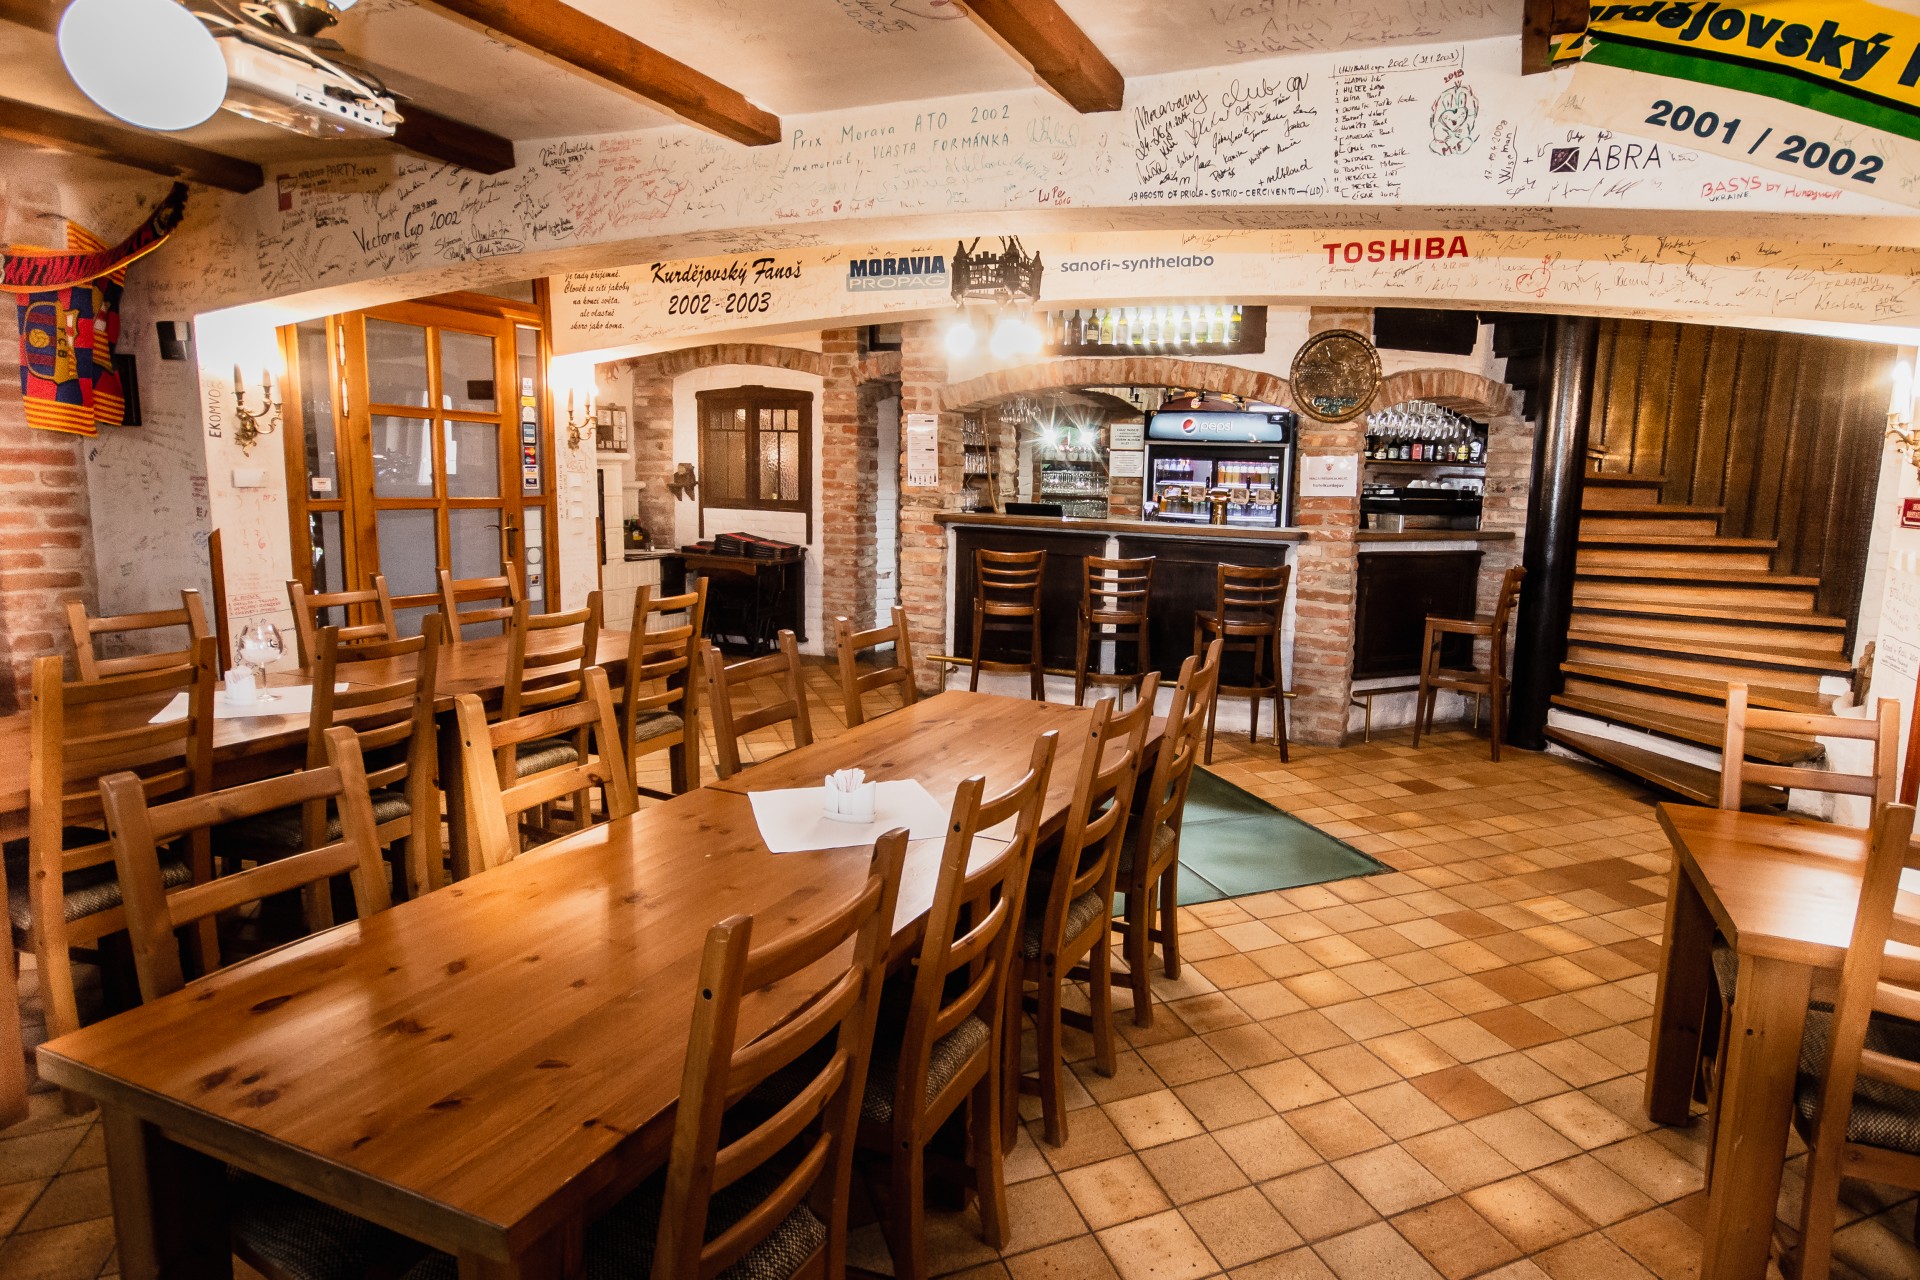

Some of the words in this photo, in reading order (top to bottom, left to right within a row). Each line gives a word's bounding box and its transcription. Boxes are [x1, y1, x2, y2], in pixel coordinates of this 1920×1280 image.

[792, 130, 822, 150] Prix
[841, 125, 895, 145] Morava
[914, 112, 948, 132] ATO
[970, 105, 1010, 123] 2002
[873, 142, 917, 160] VLASTA
[932, 132, 1009, 151] FORMÁNKA
[1644, 99, 1742, 145] 2001
[1775, 134, 1884, 185] 2002
[1583, 143, 1661, 173] ABRA
[1139, 190, 1164, 200] AGOSTO
[1701, 176, 1762, 197] BASYS
[430, 210, 461, 231] 2002
[1322, 235, 1469, 265] TOSHIBA
[574, 271, 588, 281] tady
[650, 260, 748, 288] Kurdějovský
[752, 257, 802, 285] Fanoš
[849, 255, 945, 277] MORAVIA
[564, 281, 587, 294] Člověk
[608, 281, 630, 293] jakoby
[849, 275, 946, 289] PROPAG
[583, 296, 599, 305] konci
[668, 293, 711, 316] 2002
[726, 291, 772, 314] 2003
[580, 309, 589, 317] ale
[591, 309, 615, 317] vlastně
[570, 321, 588, 330] skoro
[588, 321, 603, 332] jako
[1199, 421, 1233, 432] pepsi
